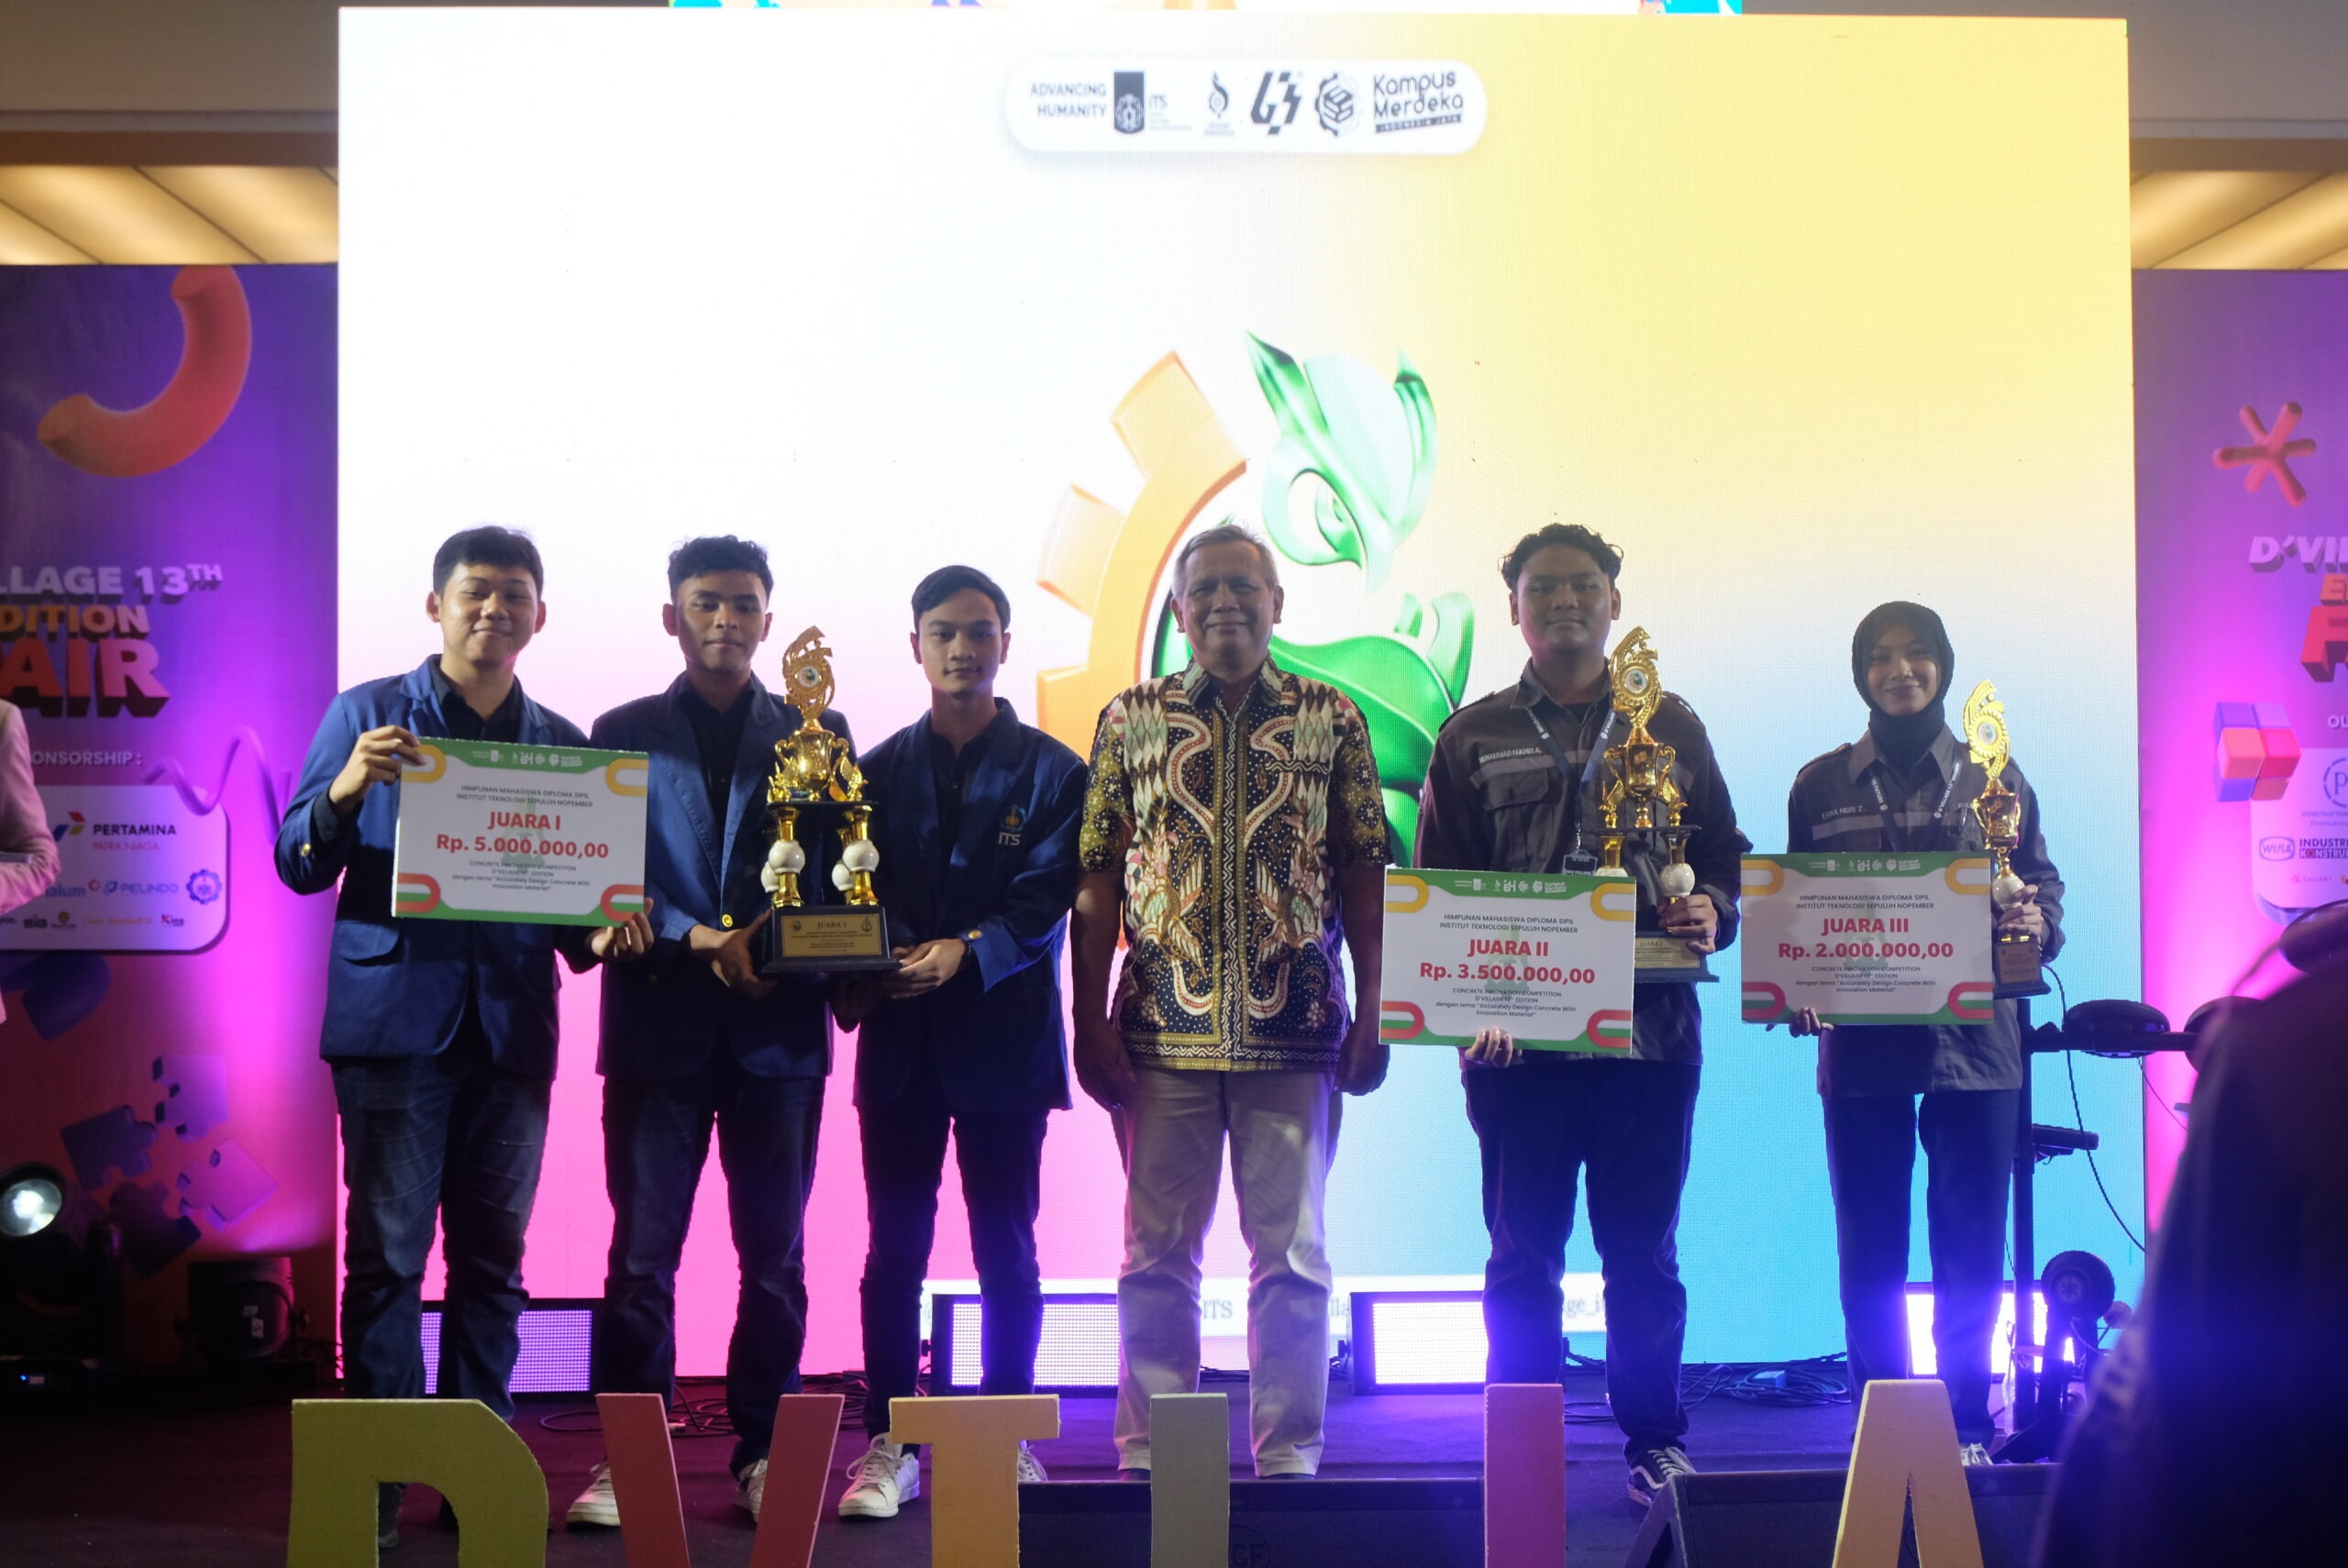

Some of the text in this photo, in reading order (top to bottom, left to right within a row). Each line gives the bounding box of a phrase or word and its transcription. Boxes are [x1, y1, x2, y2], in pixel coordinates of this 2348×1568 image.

[1030, 83, 1106, 96] ADVANCING
[1374, 71, 1456, 95] Kampus
[1037, 105, 1107, 117] HUMANITY
[1374, 94, 1464, 118] Merdeka
[0, 567, 123, 594] LAGE
[461, 785, 498, 793] HIMPUNAN
[487, 811, 560, 830] JUARA I
[93, 824, 177, 835] PERTAMINA
[437, 834, 609, 858] Rp. 5.000.000,00
[998, 832, 1022, 845] ITS
[120, 884, 179, 895] PELINDO
[1821, 919, 1909, 936] JUARA III
[1468, 939, 1548, 956] JUARA II
[1778, 943, 1953, 961] Rp. 2.000.000,00
[1421, 963, 1595, 985] Rp. 3.500.000,00
